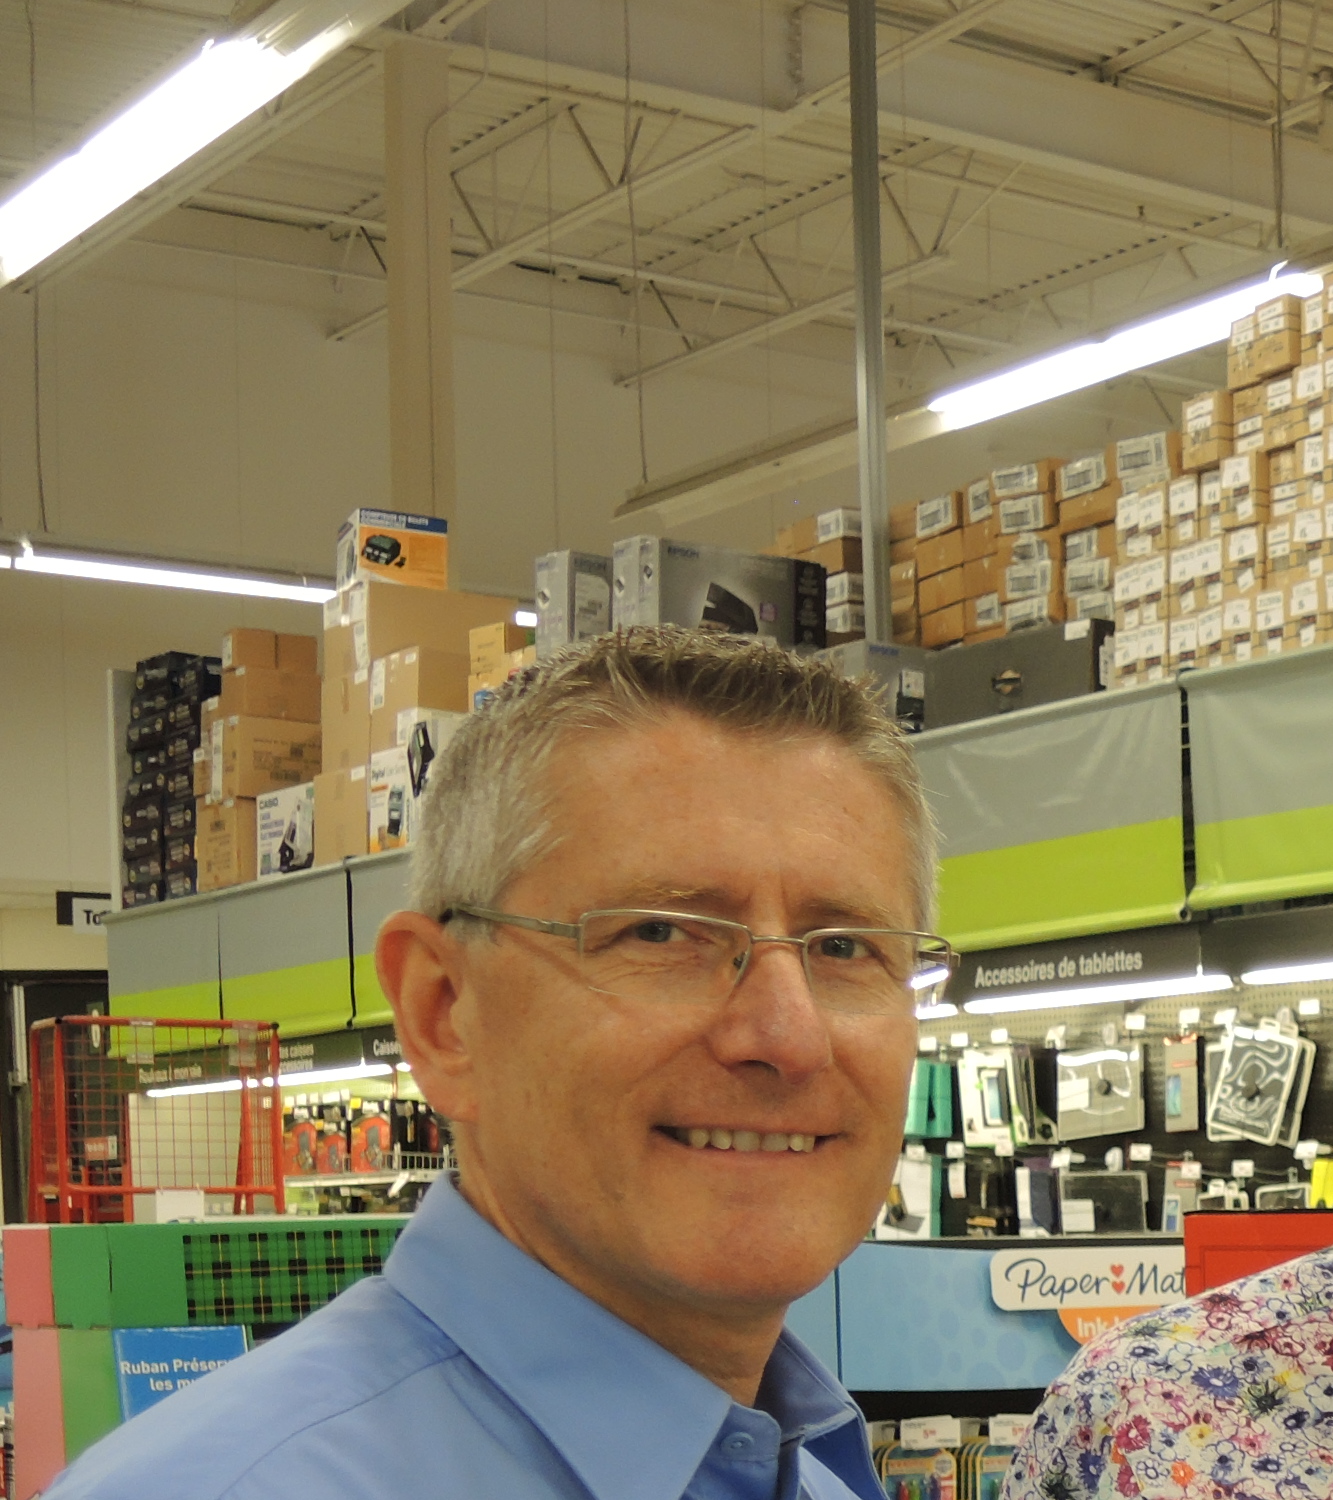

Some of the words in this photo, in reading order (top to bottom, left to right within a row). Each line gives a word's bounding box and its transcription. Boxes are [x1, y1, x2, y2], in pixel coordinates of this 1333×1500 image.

[974, 962, 1055, 989] Accessoires
[1057, 955, 1076, 979] de
[1078, 949, 1144, 976] tablettes
[1004, 1257, 1110, 1304] Paper
[119, 1360, 170, 1376] Ruban
[149, 1377, 174, 1392] les
